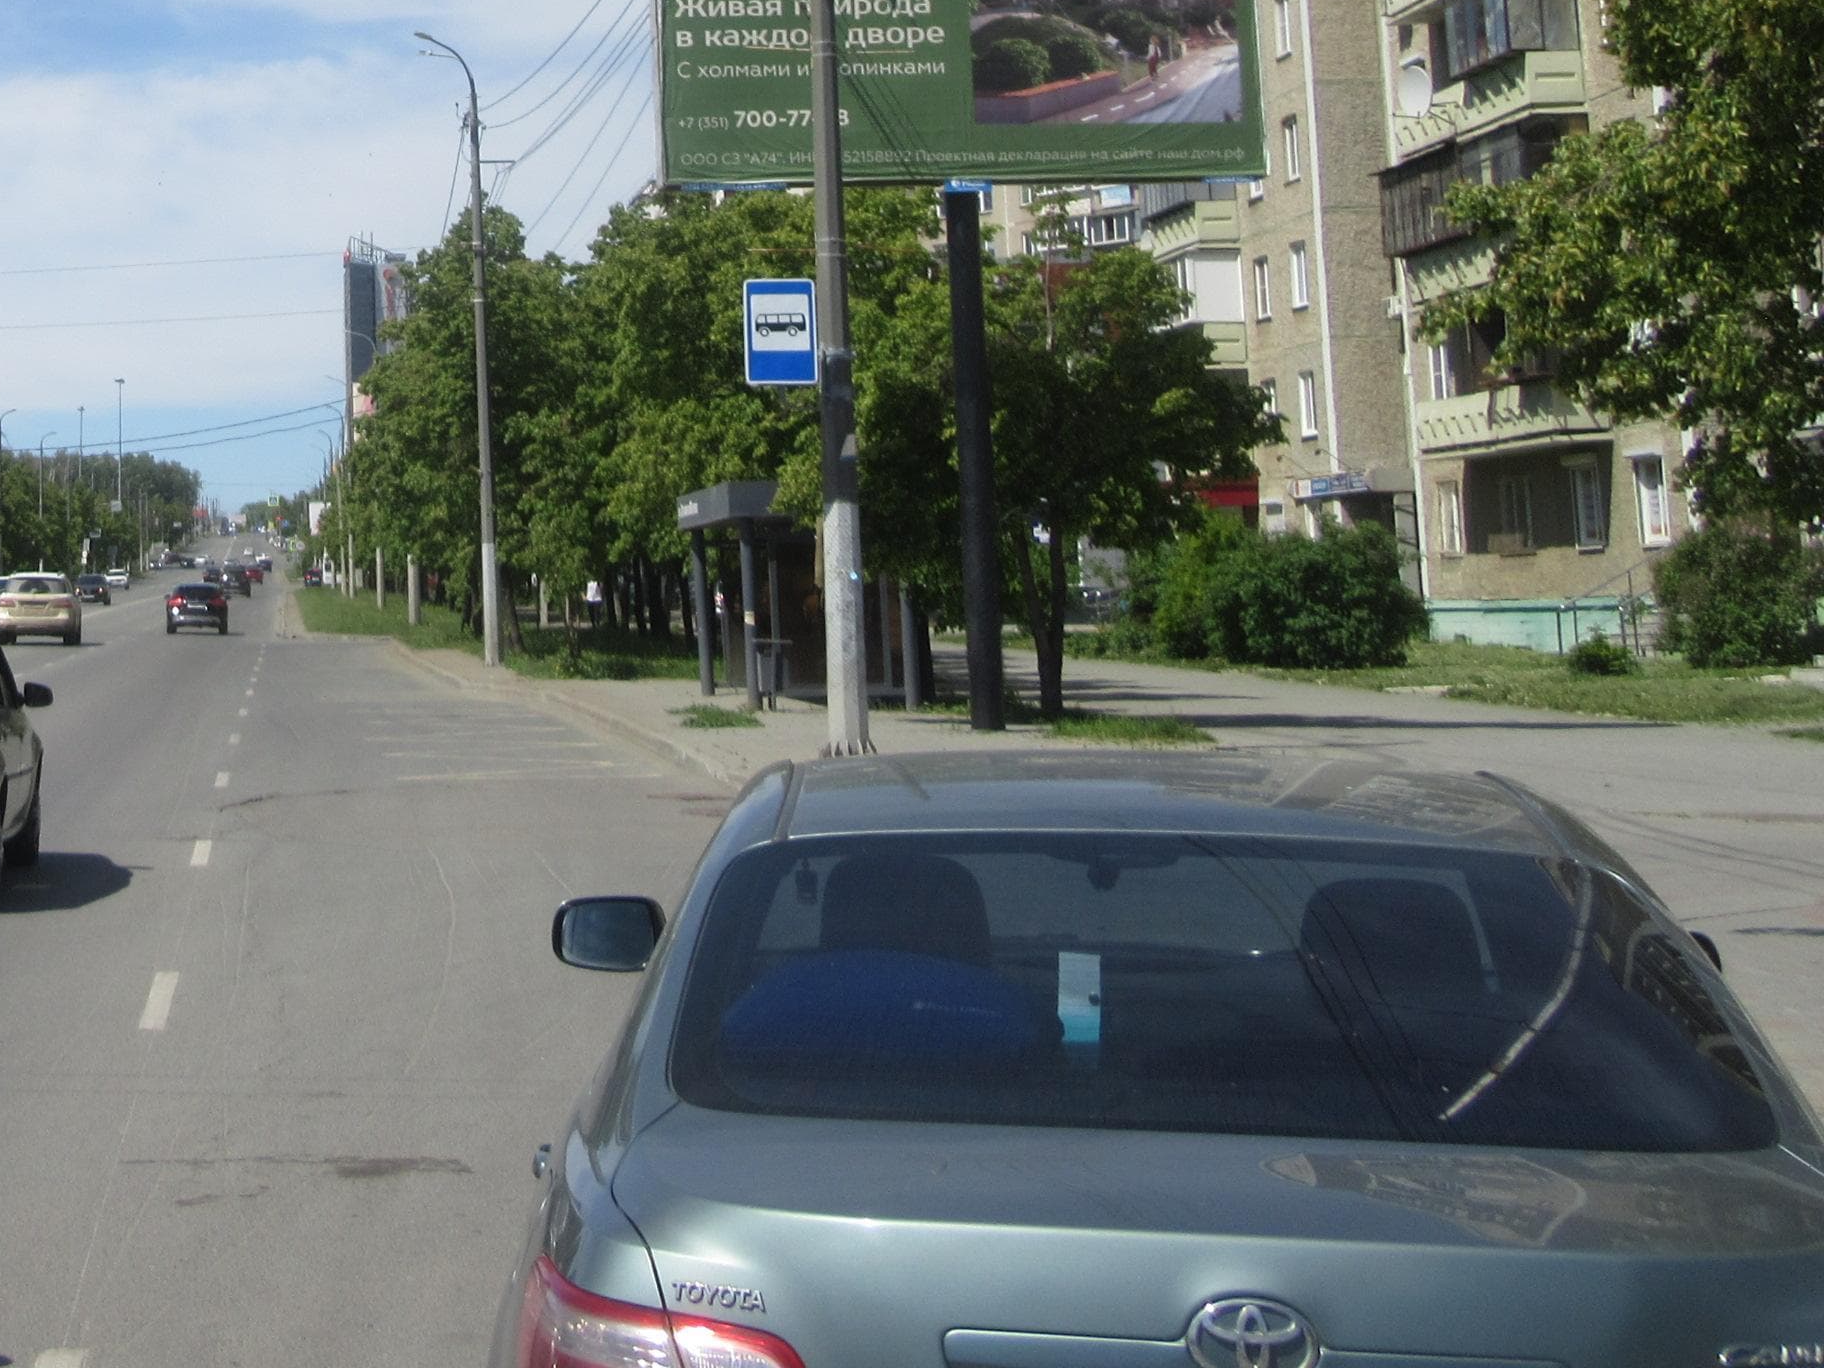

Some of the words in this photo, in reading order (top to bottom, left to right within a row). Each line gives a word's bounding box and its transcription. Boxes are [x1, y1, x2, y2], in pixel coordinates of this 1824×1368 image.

[676, 29, 694, 48] в
[704, 27, 811, 50] каждо
[844, 25, 946, 49] дворе
[676, 61, 692, 79] С
[697, 62, 791, 78] холмами
[796, 62, 810, 77] и
[838, 61, 946, 76] опинками
[678, 117, 694, 130] +7
[697, 116, 729, 131] (351)
[680, 152, 718, 166] ООО
[789, 150, 818, 165] ИН
[915, 149, 996, 164] Проектная
[998, 147, 1087, 165] декларация
[1112, 144, 1153, 162] сайте
[672, 1280, 767, 1313] TOYOTA
